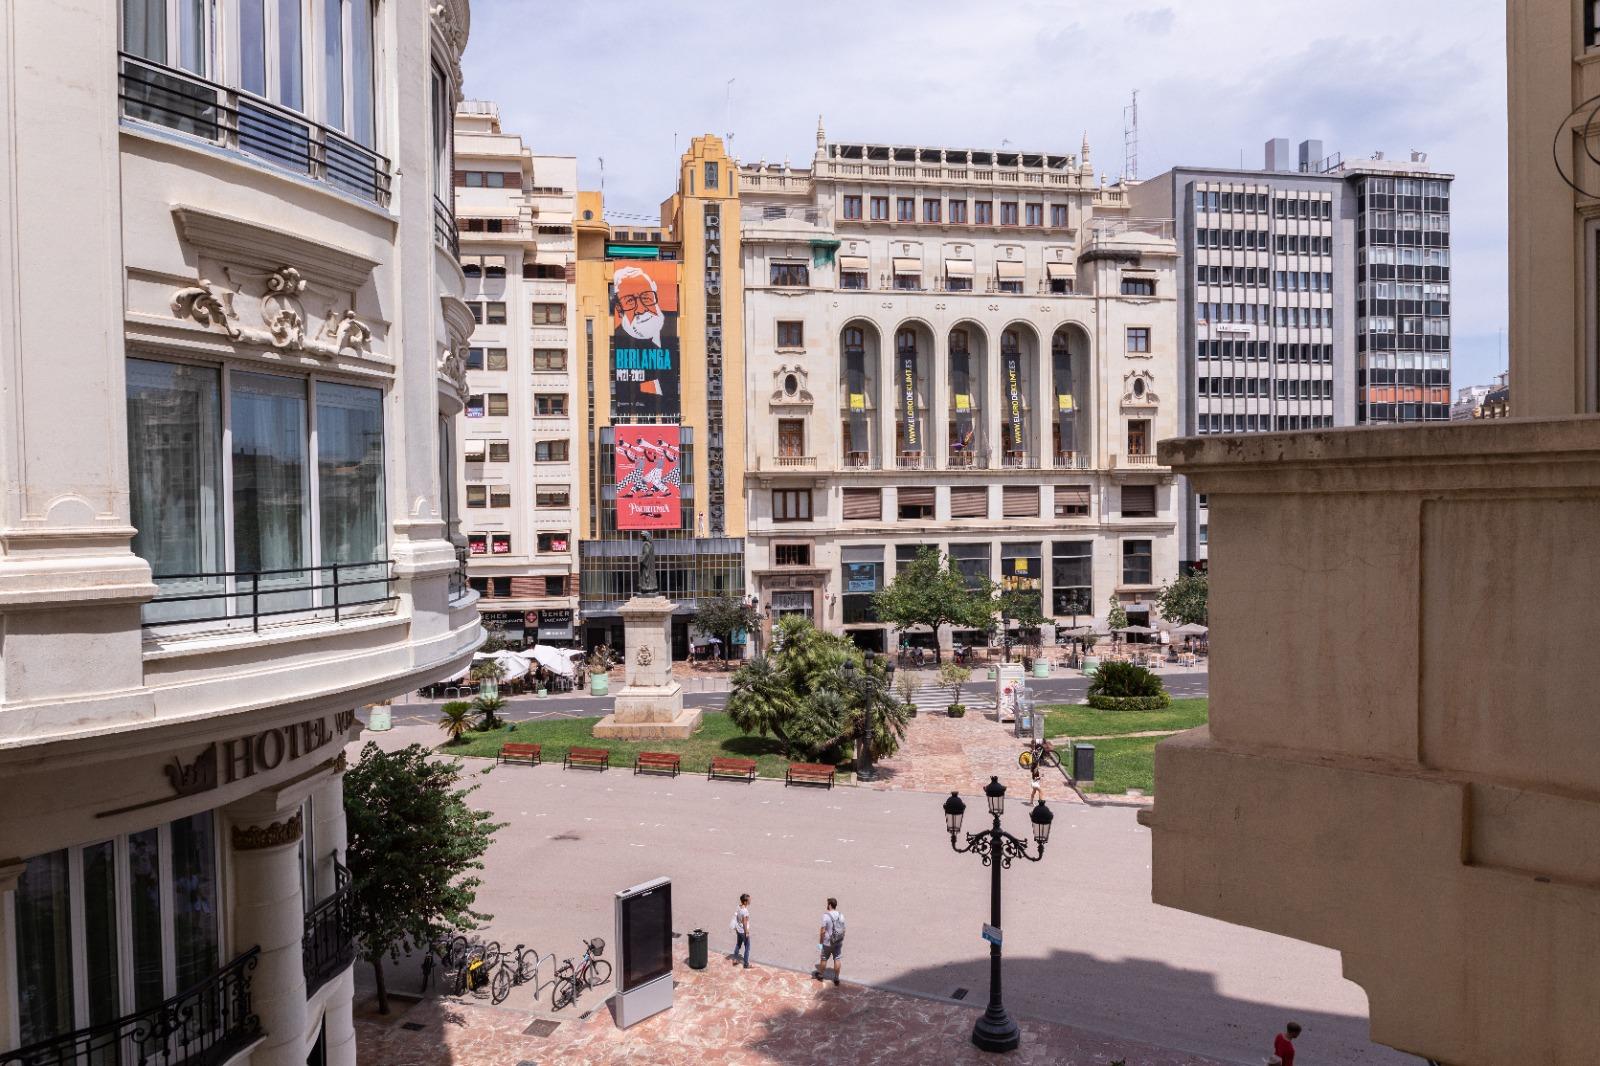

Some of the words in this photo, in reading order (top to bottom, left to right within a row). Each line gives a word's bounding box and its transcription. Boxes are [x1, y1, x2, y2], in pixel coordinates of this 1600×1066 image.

[616, 348, 672, 370] BERLANGA
[905, 359, 917, 444] WWW.ELORODEKLIMT.ES
[1008, 360, 1022, 444] WWW.ELORODEKLIMT.ES
[222, 716, 333, 784] HOTEL
